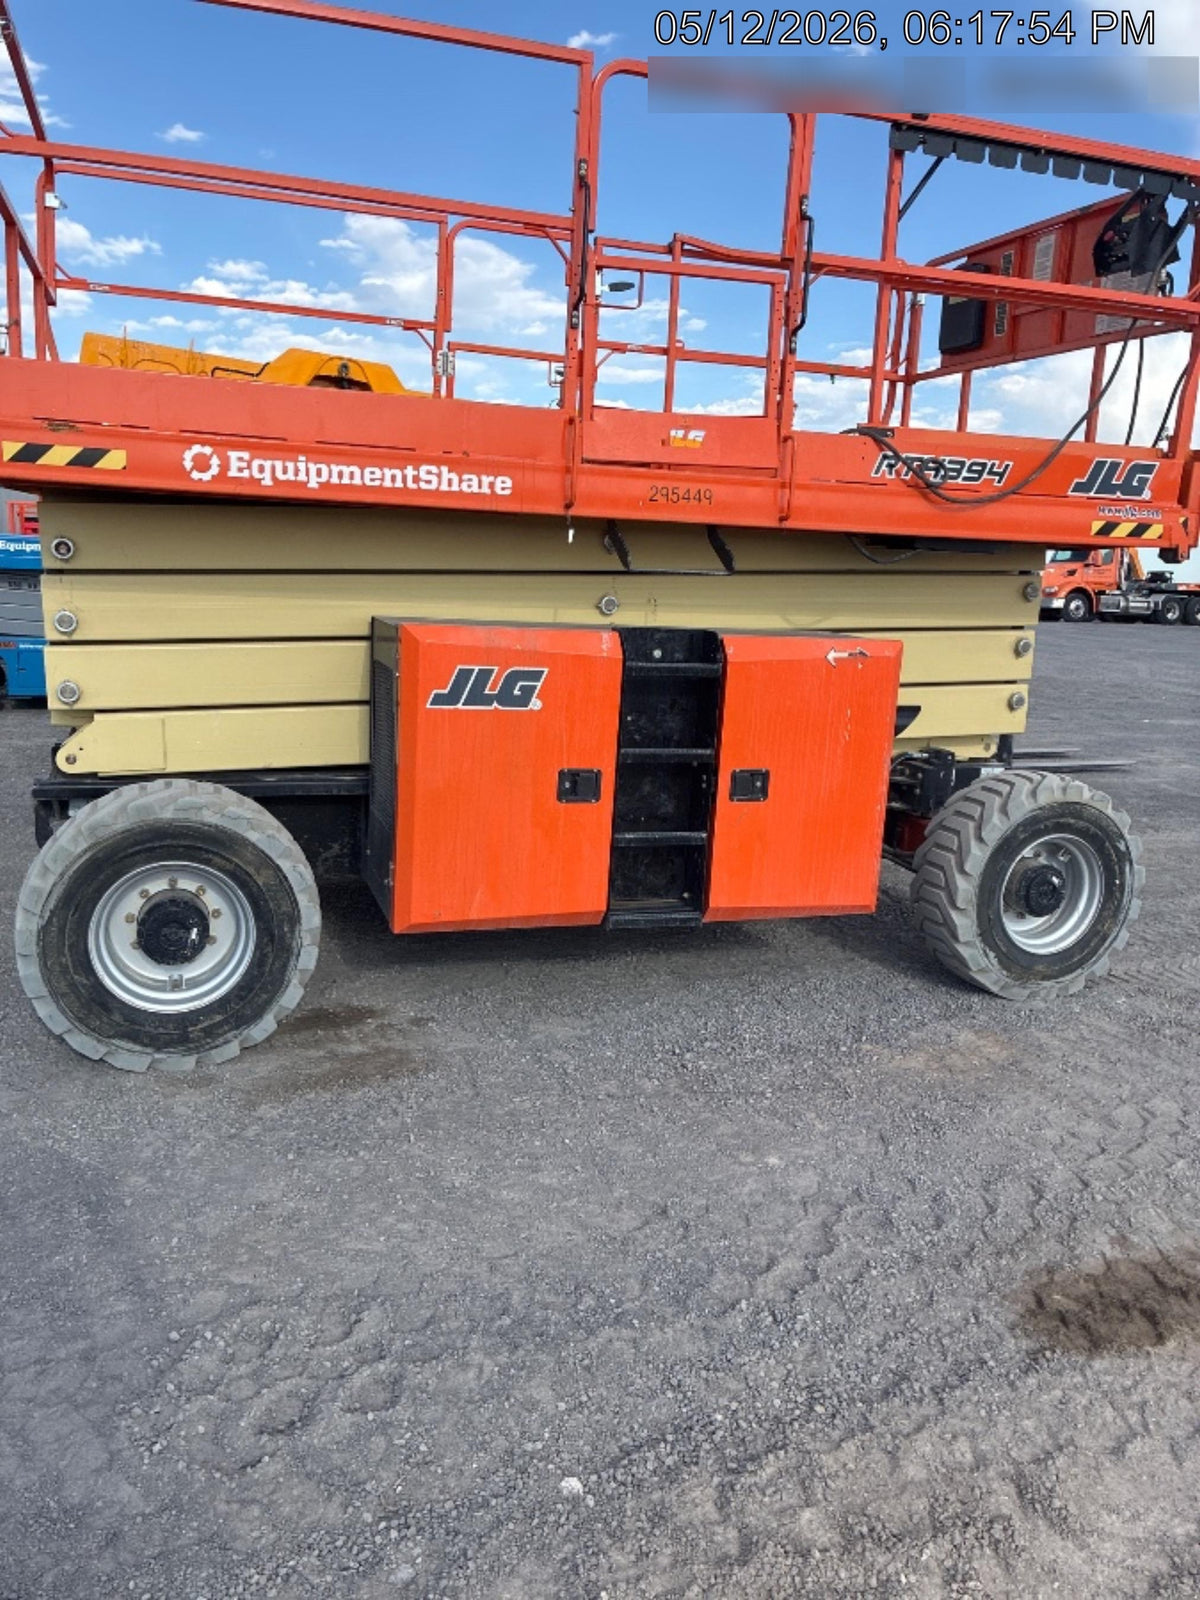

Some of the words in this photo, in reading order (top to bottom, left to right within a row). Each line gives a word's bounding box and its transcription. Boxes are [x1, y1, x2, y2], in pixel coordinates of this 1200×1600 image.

[226, 449, 513, 496] EquipmentShare
[1067, 458, 1159, 500] JLG
[649, 485, 713, 505] 295449
[426, 664, 549, 711] JLG
